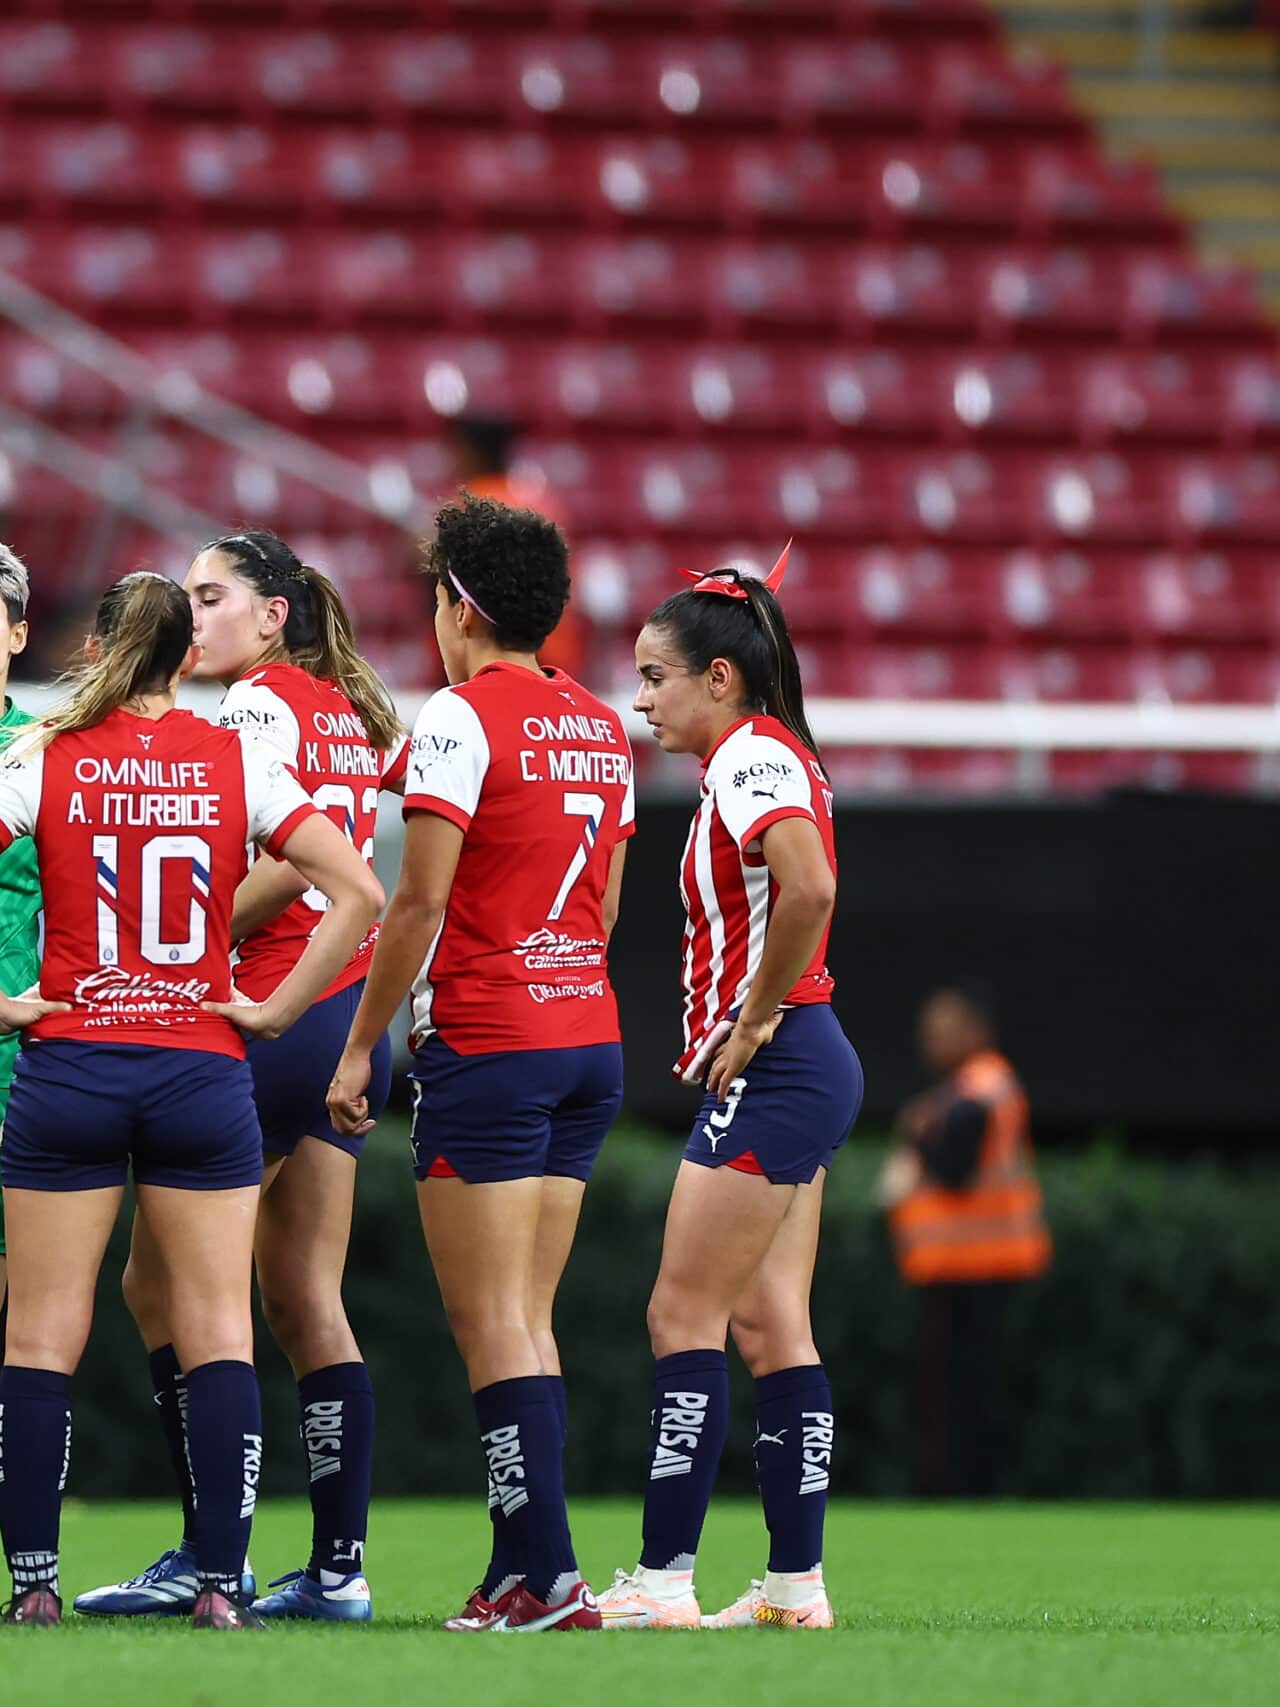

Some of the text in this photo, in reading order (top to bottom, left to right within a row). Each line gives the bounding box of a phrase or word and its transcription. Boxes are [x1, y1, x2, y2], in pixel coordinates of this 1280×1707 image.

[305, 741, 326, 773] K.
[520, 750, 629, 785] C. MONTERO
[523, 715, 617, 744] OMNILIFE
[67, 792, 221, 827] A. ITURBIDE
[75, 757, 209, 788] OMNILIFE
[546, 792, 606, 921] 7
[93, 835, 211, 965] 10
[304, 1400, 345, 1483] PRISA
[480, 1423, 529, 1519] PRISA
[650, 1391, 710, 1480] PRISA
[798, 1411, 834, 1495] PRISA
